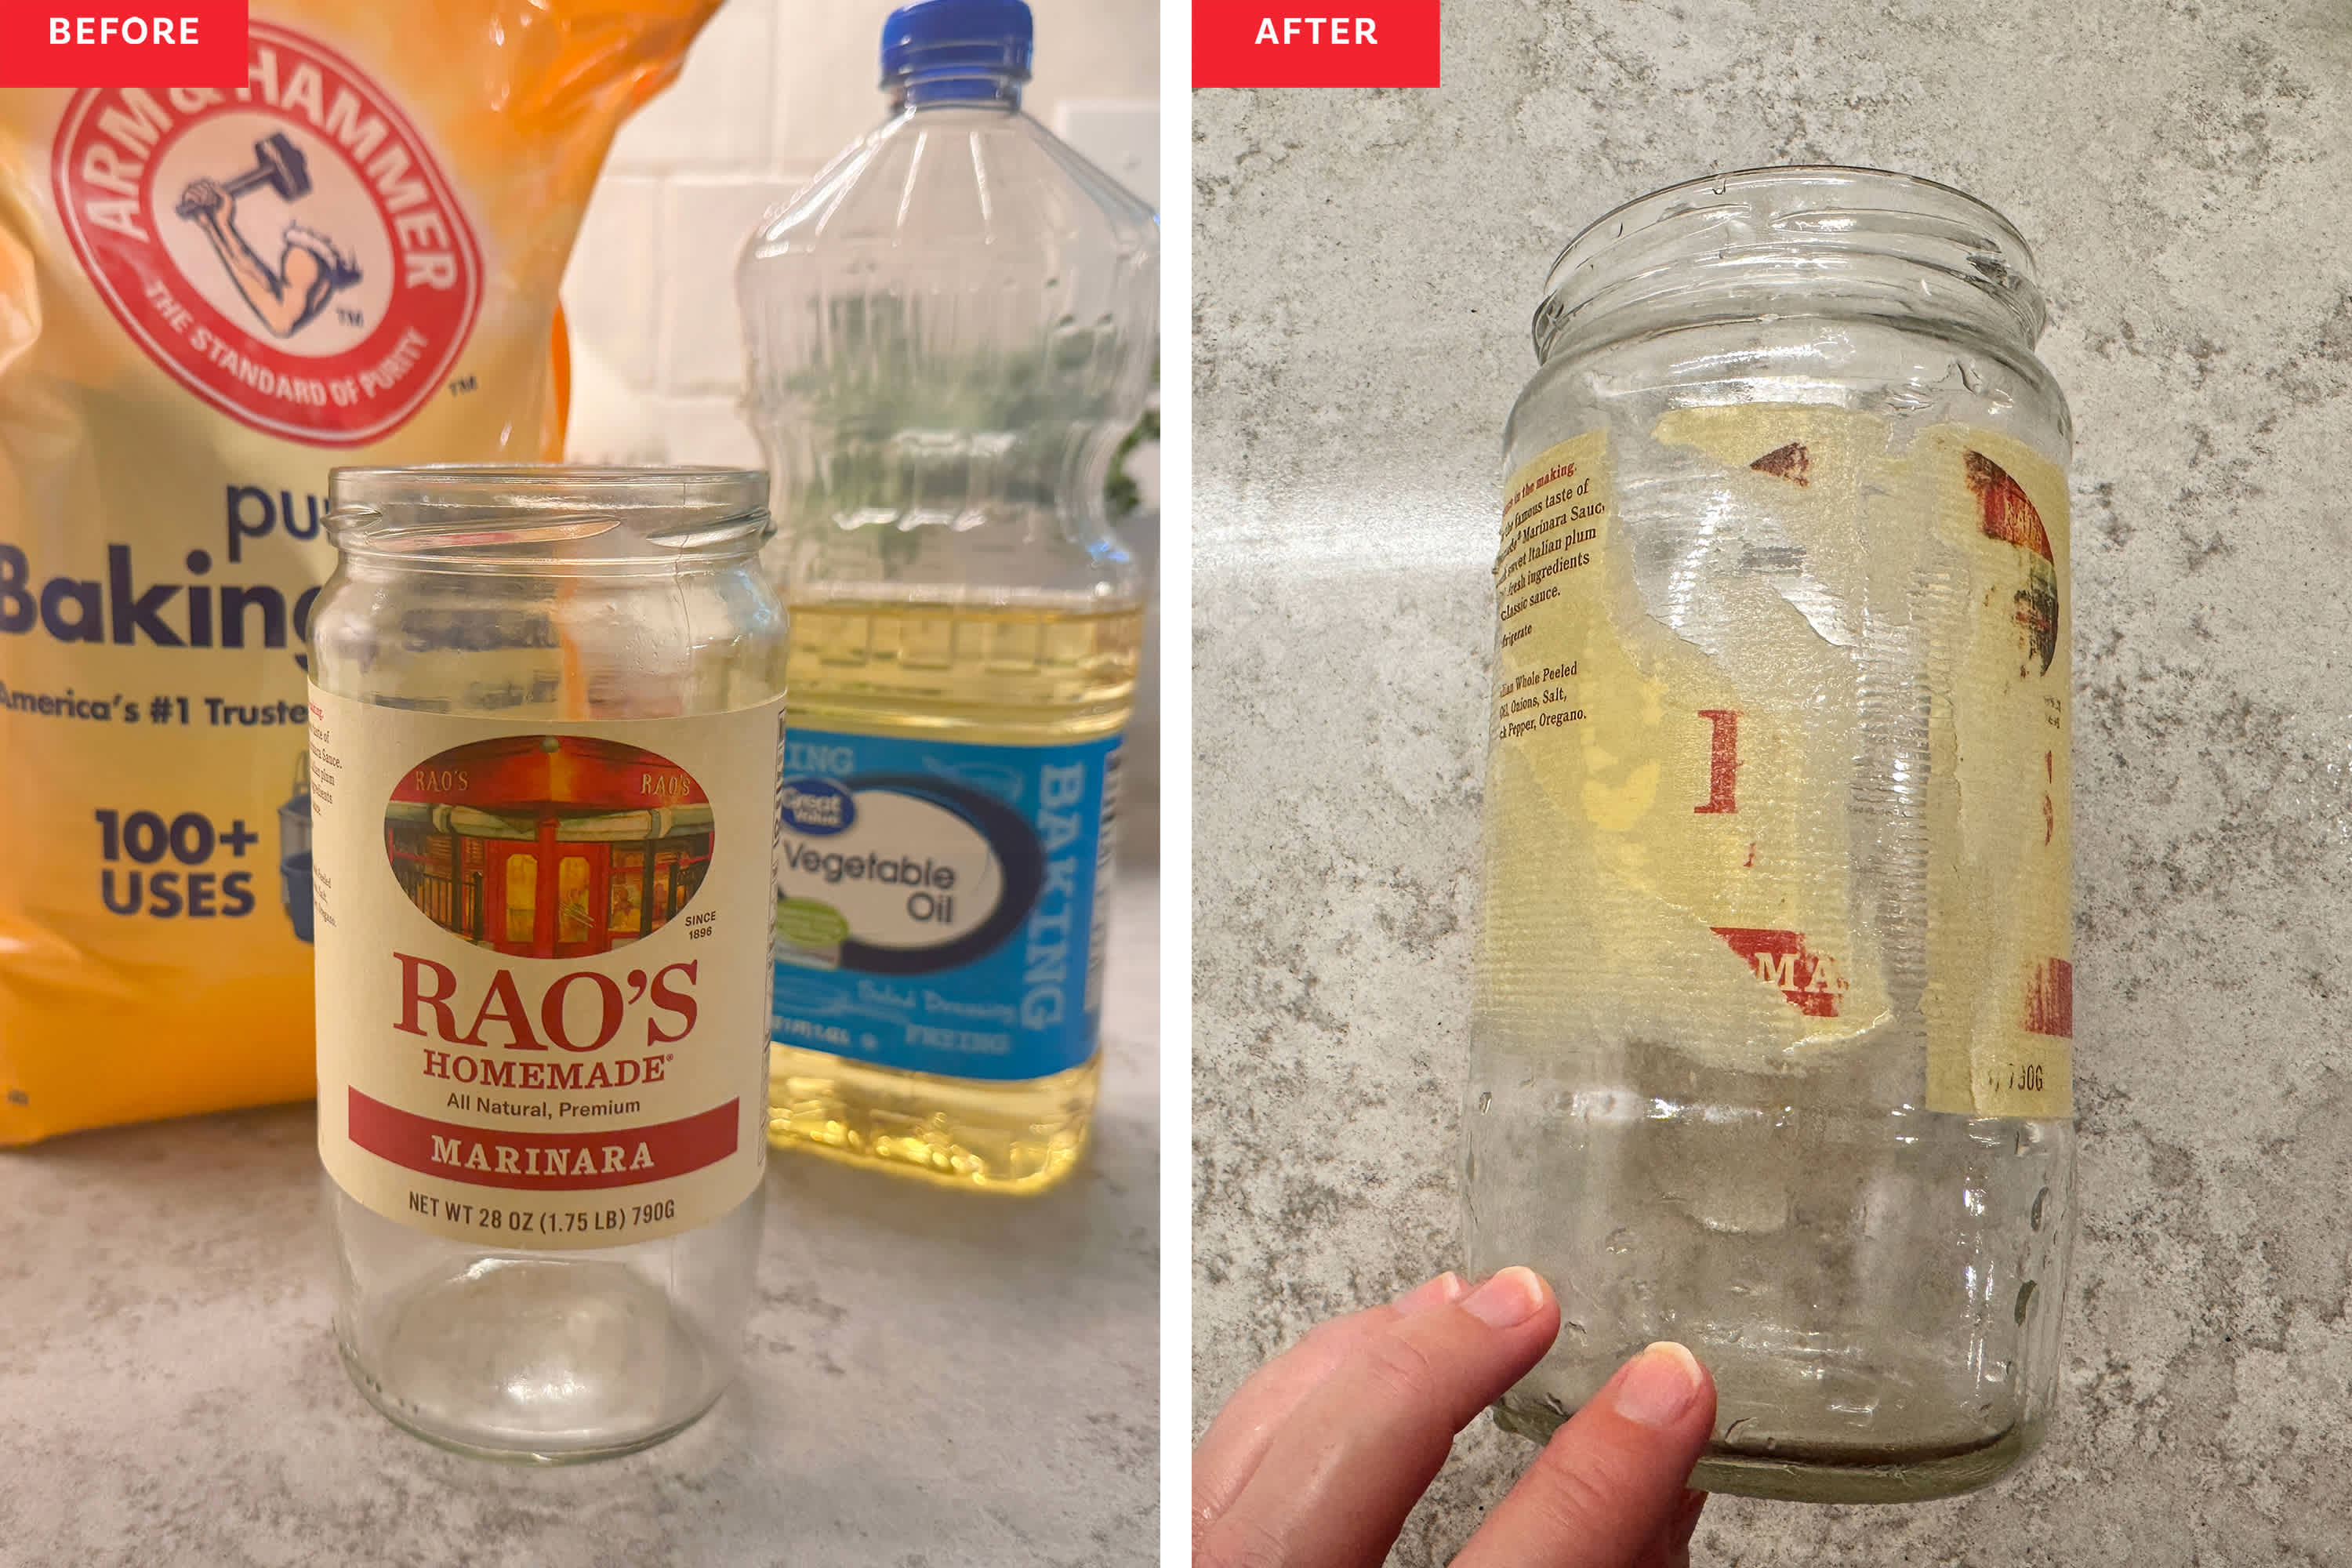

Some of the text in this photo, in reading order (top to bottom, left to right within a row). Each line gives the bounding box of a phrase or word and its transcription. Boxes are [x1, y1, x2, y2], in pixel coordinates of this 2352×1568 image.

[82, 87, 174, 243] ARM
[235, 47, 458, 292] HAMMER
[144, 279, 430, 408] THE STANDARD OF PURITY
[1522, 483, 1534, 498] the
[1536, 463, 1577, 490] making.
[1545, 488, 1573, 509] taste
[1577, 477, 1590, 496] of
[226, 484, 328, 564] pu
[1522, 512, 1567, 544] Marinara
[1570, 501, 1605, 522] Sauc
[1528, 538, 1563, 563] Italian
[1565, 527, 1597, 551] plum
[1527, 551, 1591, 586] ingredients
[1500, 597, 1529, 622] classic
[1530, 586, 1561, 607] sauce.
[1515, 670, 1541, 691] Whole
[1542, 660, 1578, 683] Peeled
[0, 681, 140, 724] America's
[150, 695, 190, 725] #1
[205, 696, 308, 726] Truste
[1542, 687, 1567, 705] Salt,
[1539, 708, 1588, 728] Oregano.
[416, 770, 469, 792] RAO'S
[640, 772, 691, 797] RAO'S
[94, 808, 259, 866] 100+
[782, 841, 956, 892] Vegetable
[100, 869, 256, 920] USES
[906, 891, 954, 924] Oil
[1021, 762, 1087, 1031] BAKING
[684, 910, 717, 927] SINCE
[689, 926, 713, 940] 1896
[392, 952, 699, 1053] RAO'S
[446, 1092, 641, 1120] All Natural, Premium
[430, 1134, 655, 1176] MARINARA
[408, 1191, 676, 1236] NET WT 28 OZ (1.75 LB) 790G
